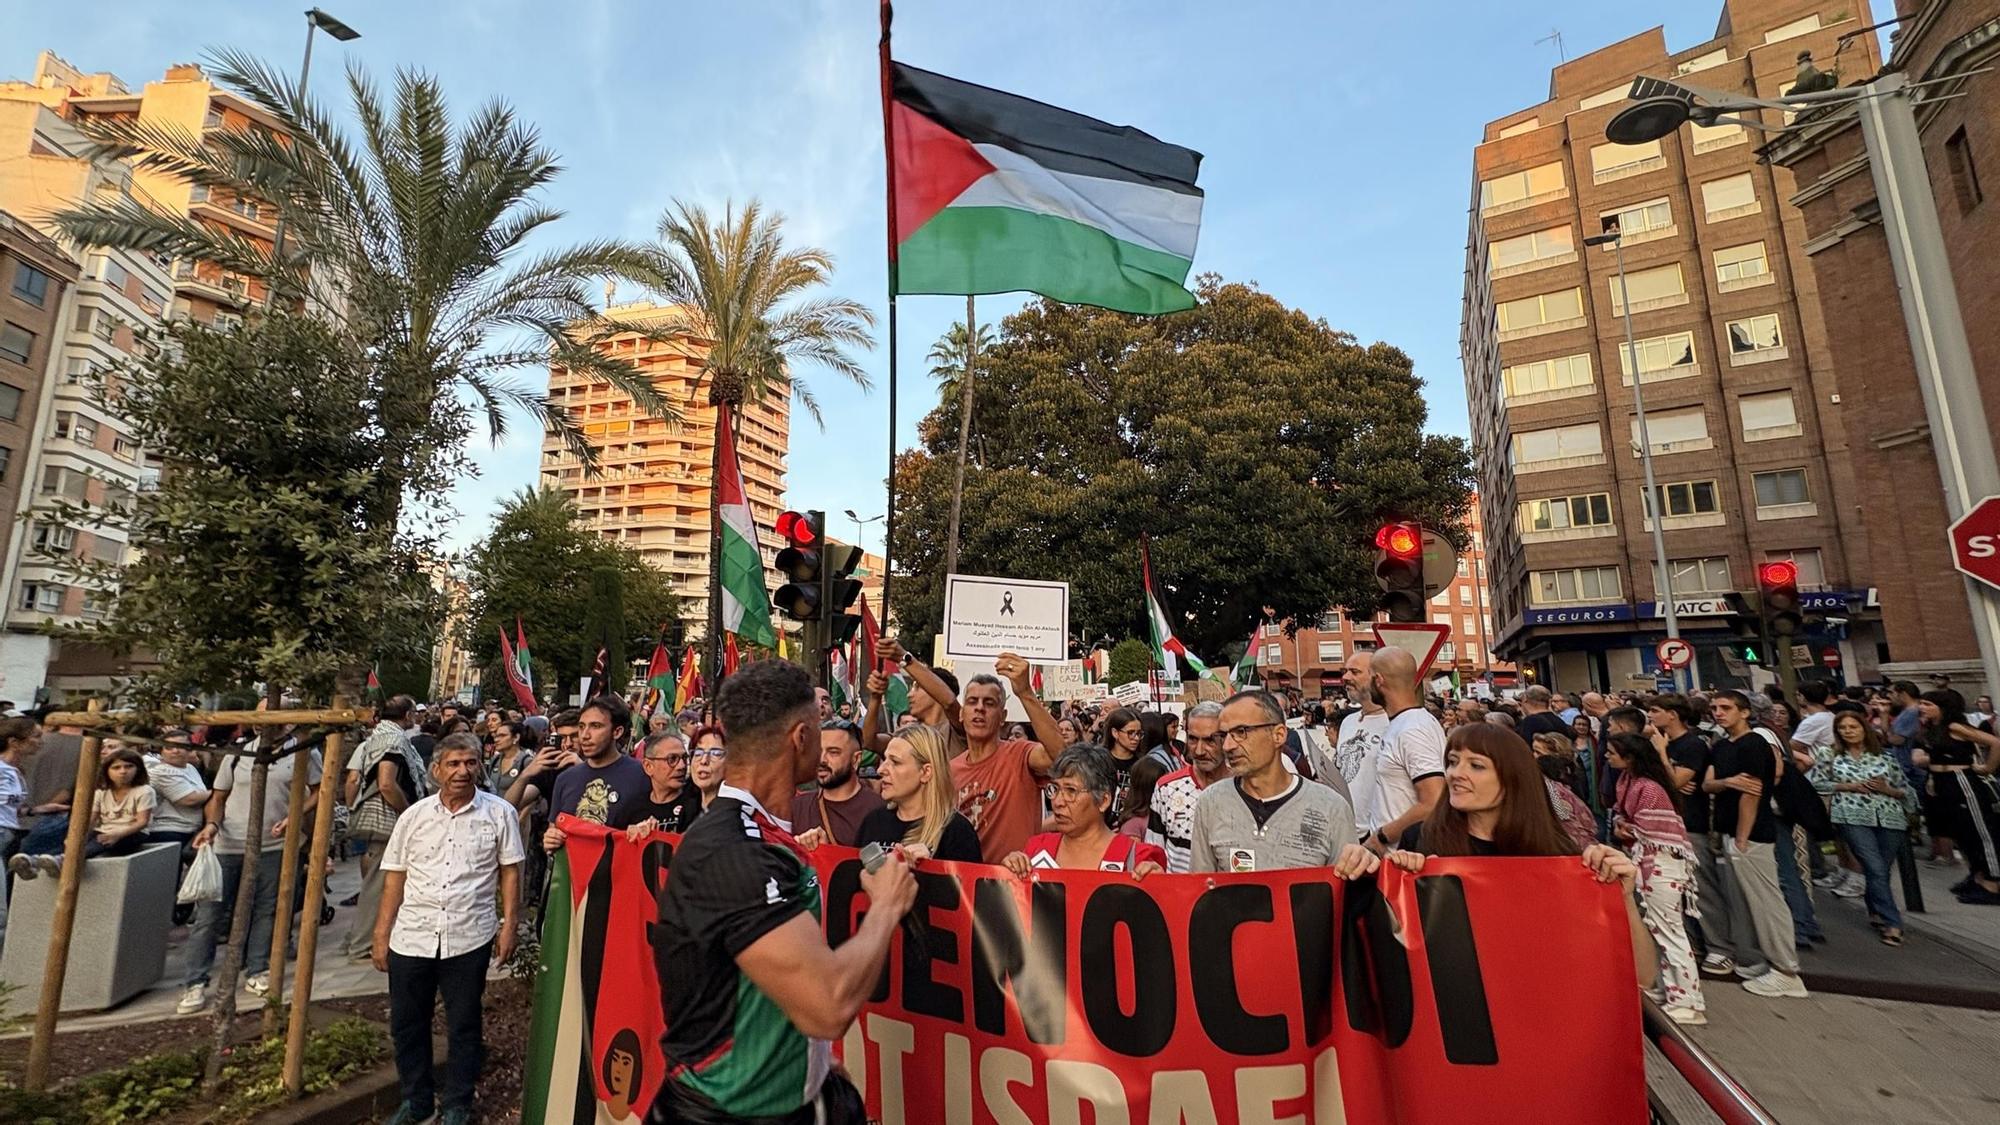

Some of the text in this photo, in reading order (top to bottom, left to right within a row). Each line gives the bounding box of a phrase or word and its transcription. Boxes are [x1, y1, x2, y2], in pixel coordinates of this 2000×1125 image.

[1968, 535, 2000, 558] S
[1536, 610, 1617, 623] SEGUROS
[1060, 664, 1081, 674] FREE
[1059, 674, 1083, 683] GAZA
